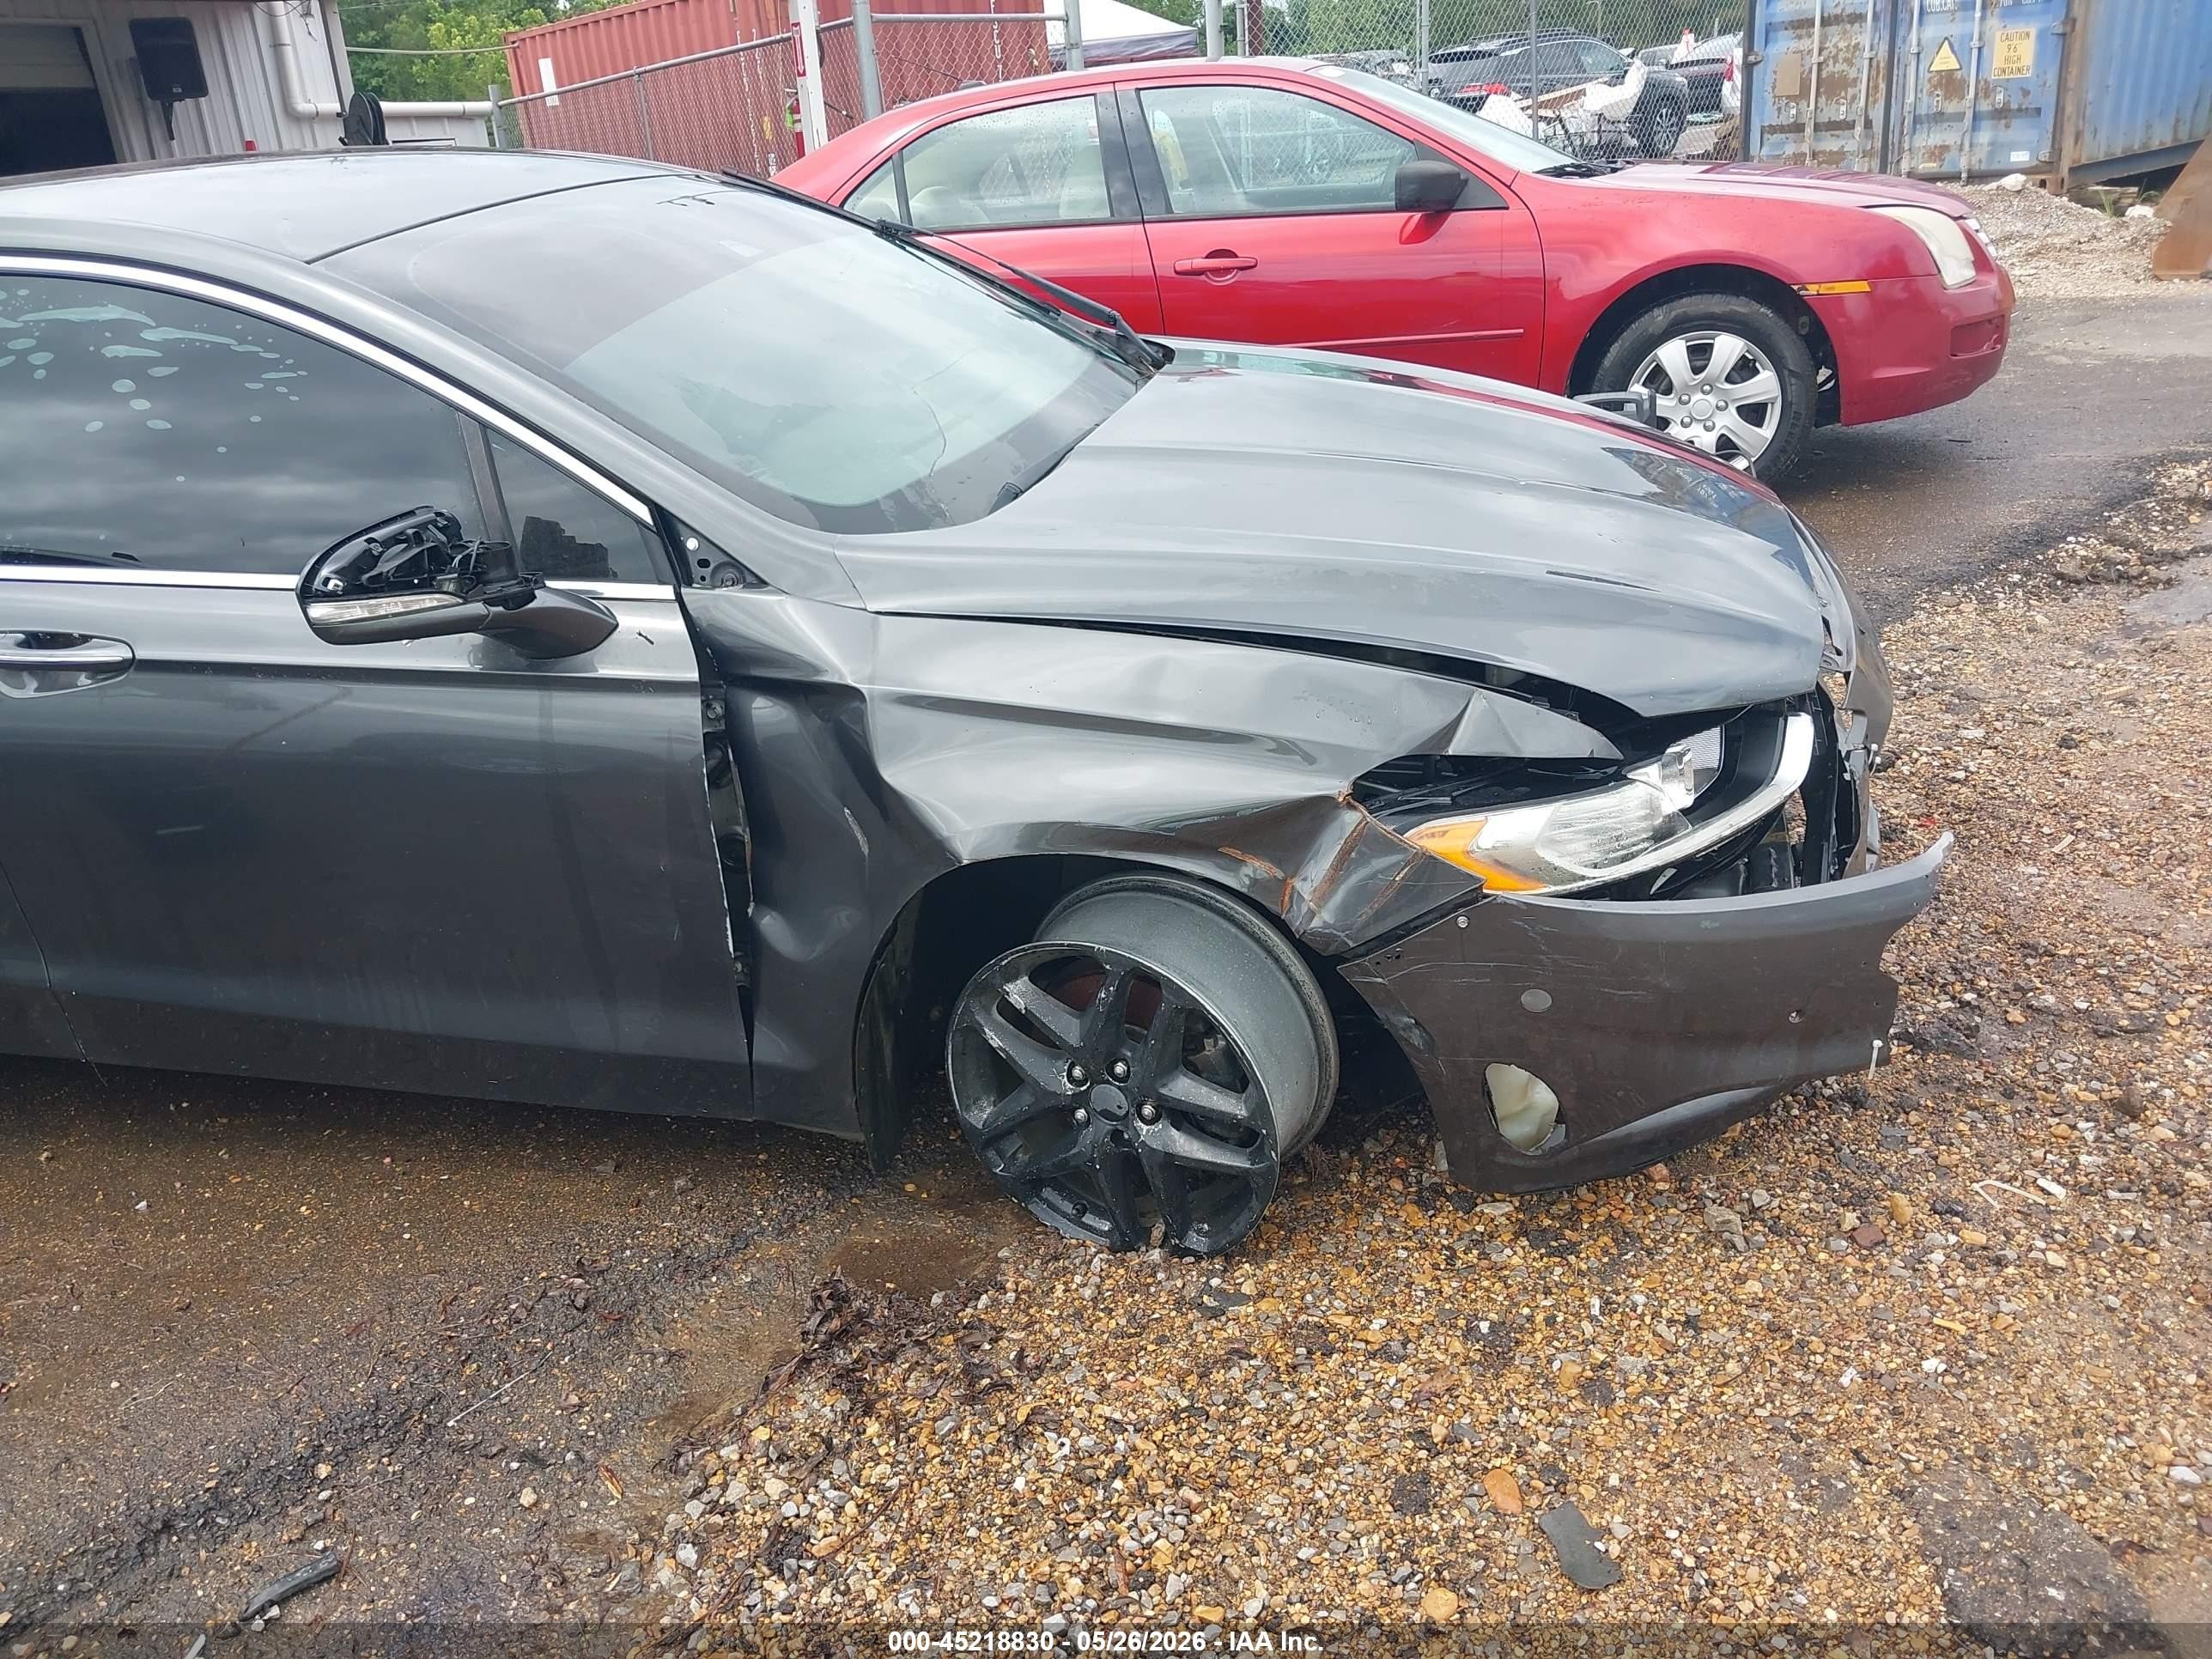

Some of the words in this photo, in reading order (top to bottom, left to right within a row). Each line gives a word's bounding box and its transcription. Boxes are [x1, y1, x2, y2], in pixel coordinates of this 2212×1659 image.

[2000, 31, 2031, 43] CAUTION
[2003, 54, 2021, 65] HIGH
[1993, 65, 2031, 77] CONTAINER
